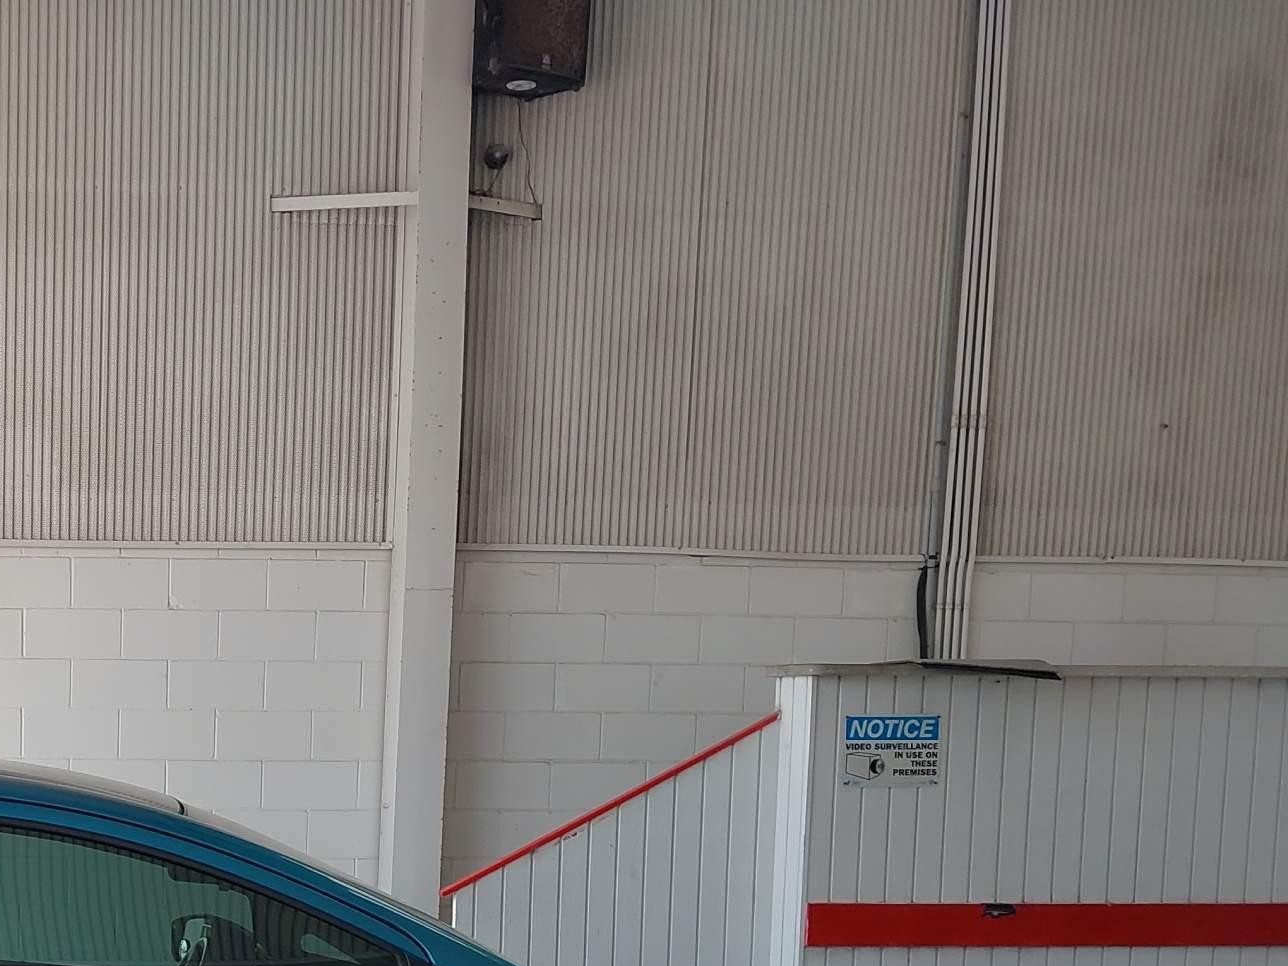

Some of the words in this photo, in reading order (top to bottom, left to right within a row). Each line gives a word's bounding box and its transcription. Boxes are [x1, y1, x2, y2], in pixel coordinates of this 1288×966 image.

[849, 719, 936, 738] NOTICE
[906, 751, 923, 759] USE
[925, 751, 938, 759] ON
[892, 768, 937, 776] PREMISES
